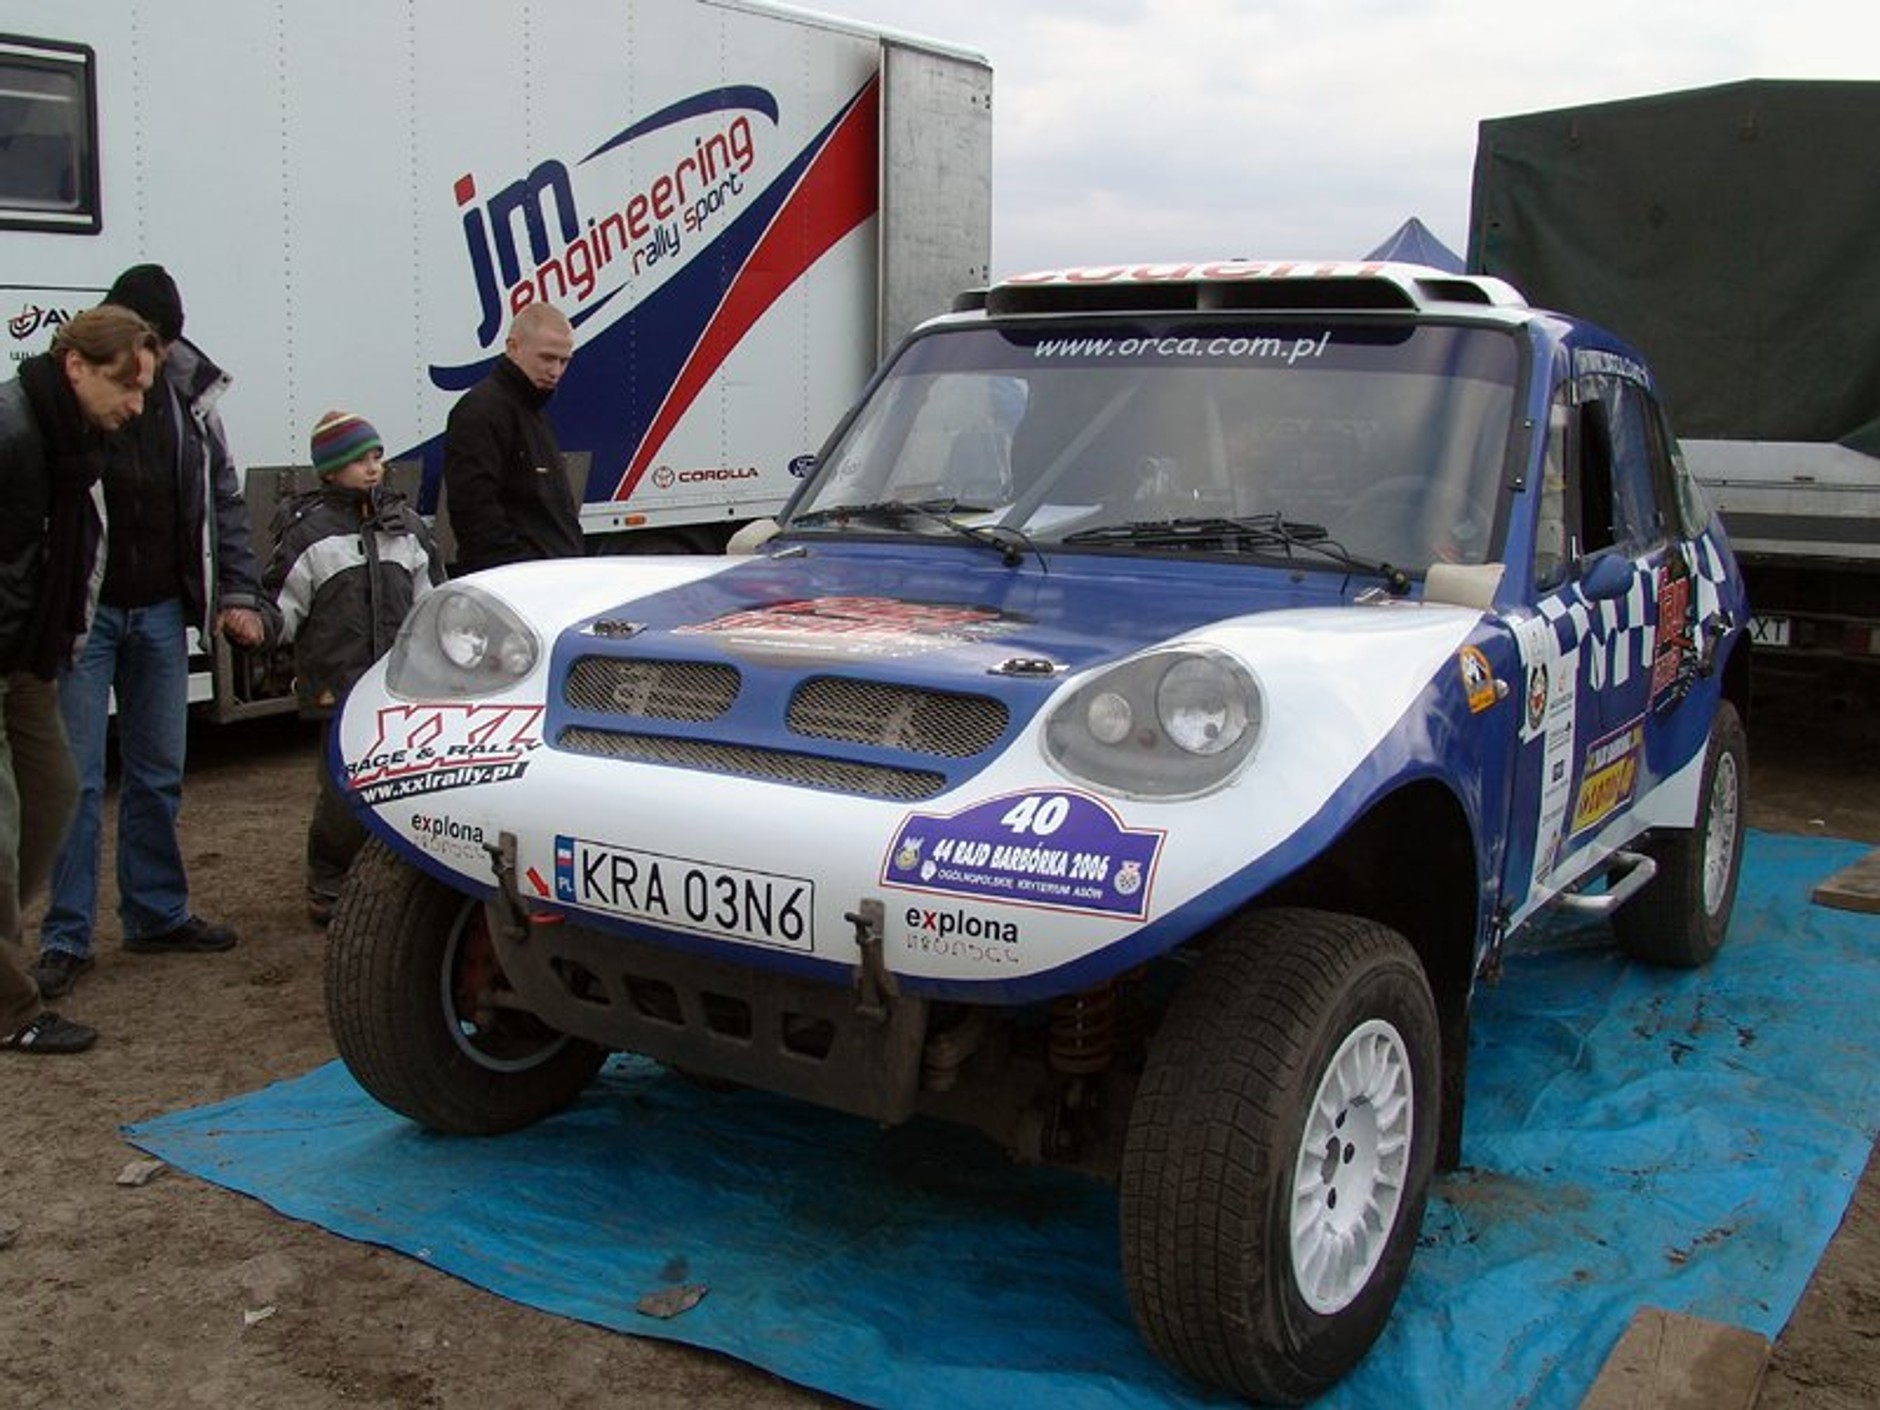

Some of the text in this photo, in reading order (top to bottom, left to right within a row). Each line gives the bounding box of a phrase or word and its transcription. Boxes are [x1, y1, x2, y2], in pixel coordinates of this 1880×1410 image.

[510, 115, 754, 317] engineering
[632, 171, 744, 275] rally sport
[453, 160, 580, 349] jm
[1034, 332, 1330, 363] www.orca.com.pl
[679, 467, 759, 483] COROLLA
[345, 742, 543, 774] RACE & RALLY
[346, 704, 545, 790] XXL
[411, 814, 483, 843] explona
[1001, 796, 1070, 835] 40
[932, 839, 1110, 881] 44 RAJD BARBÓRKA 2006
[559, 877, 573, 892] PL
[583, 849, 804, 940] KRA 03N6
[906, 907, 1018, 943] explona
